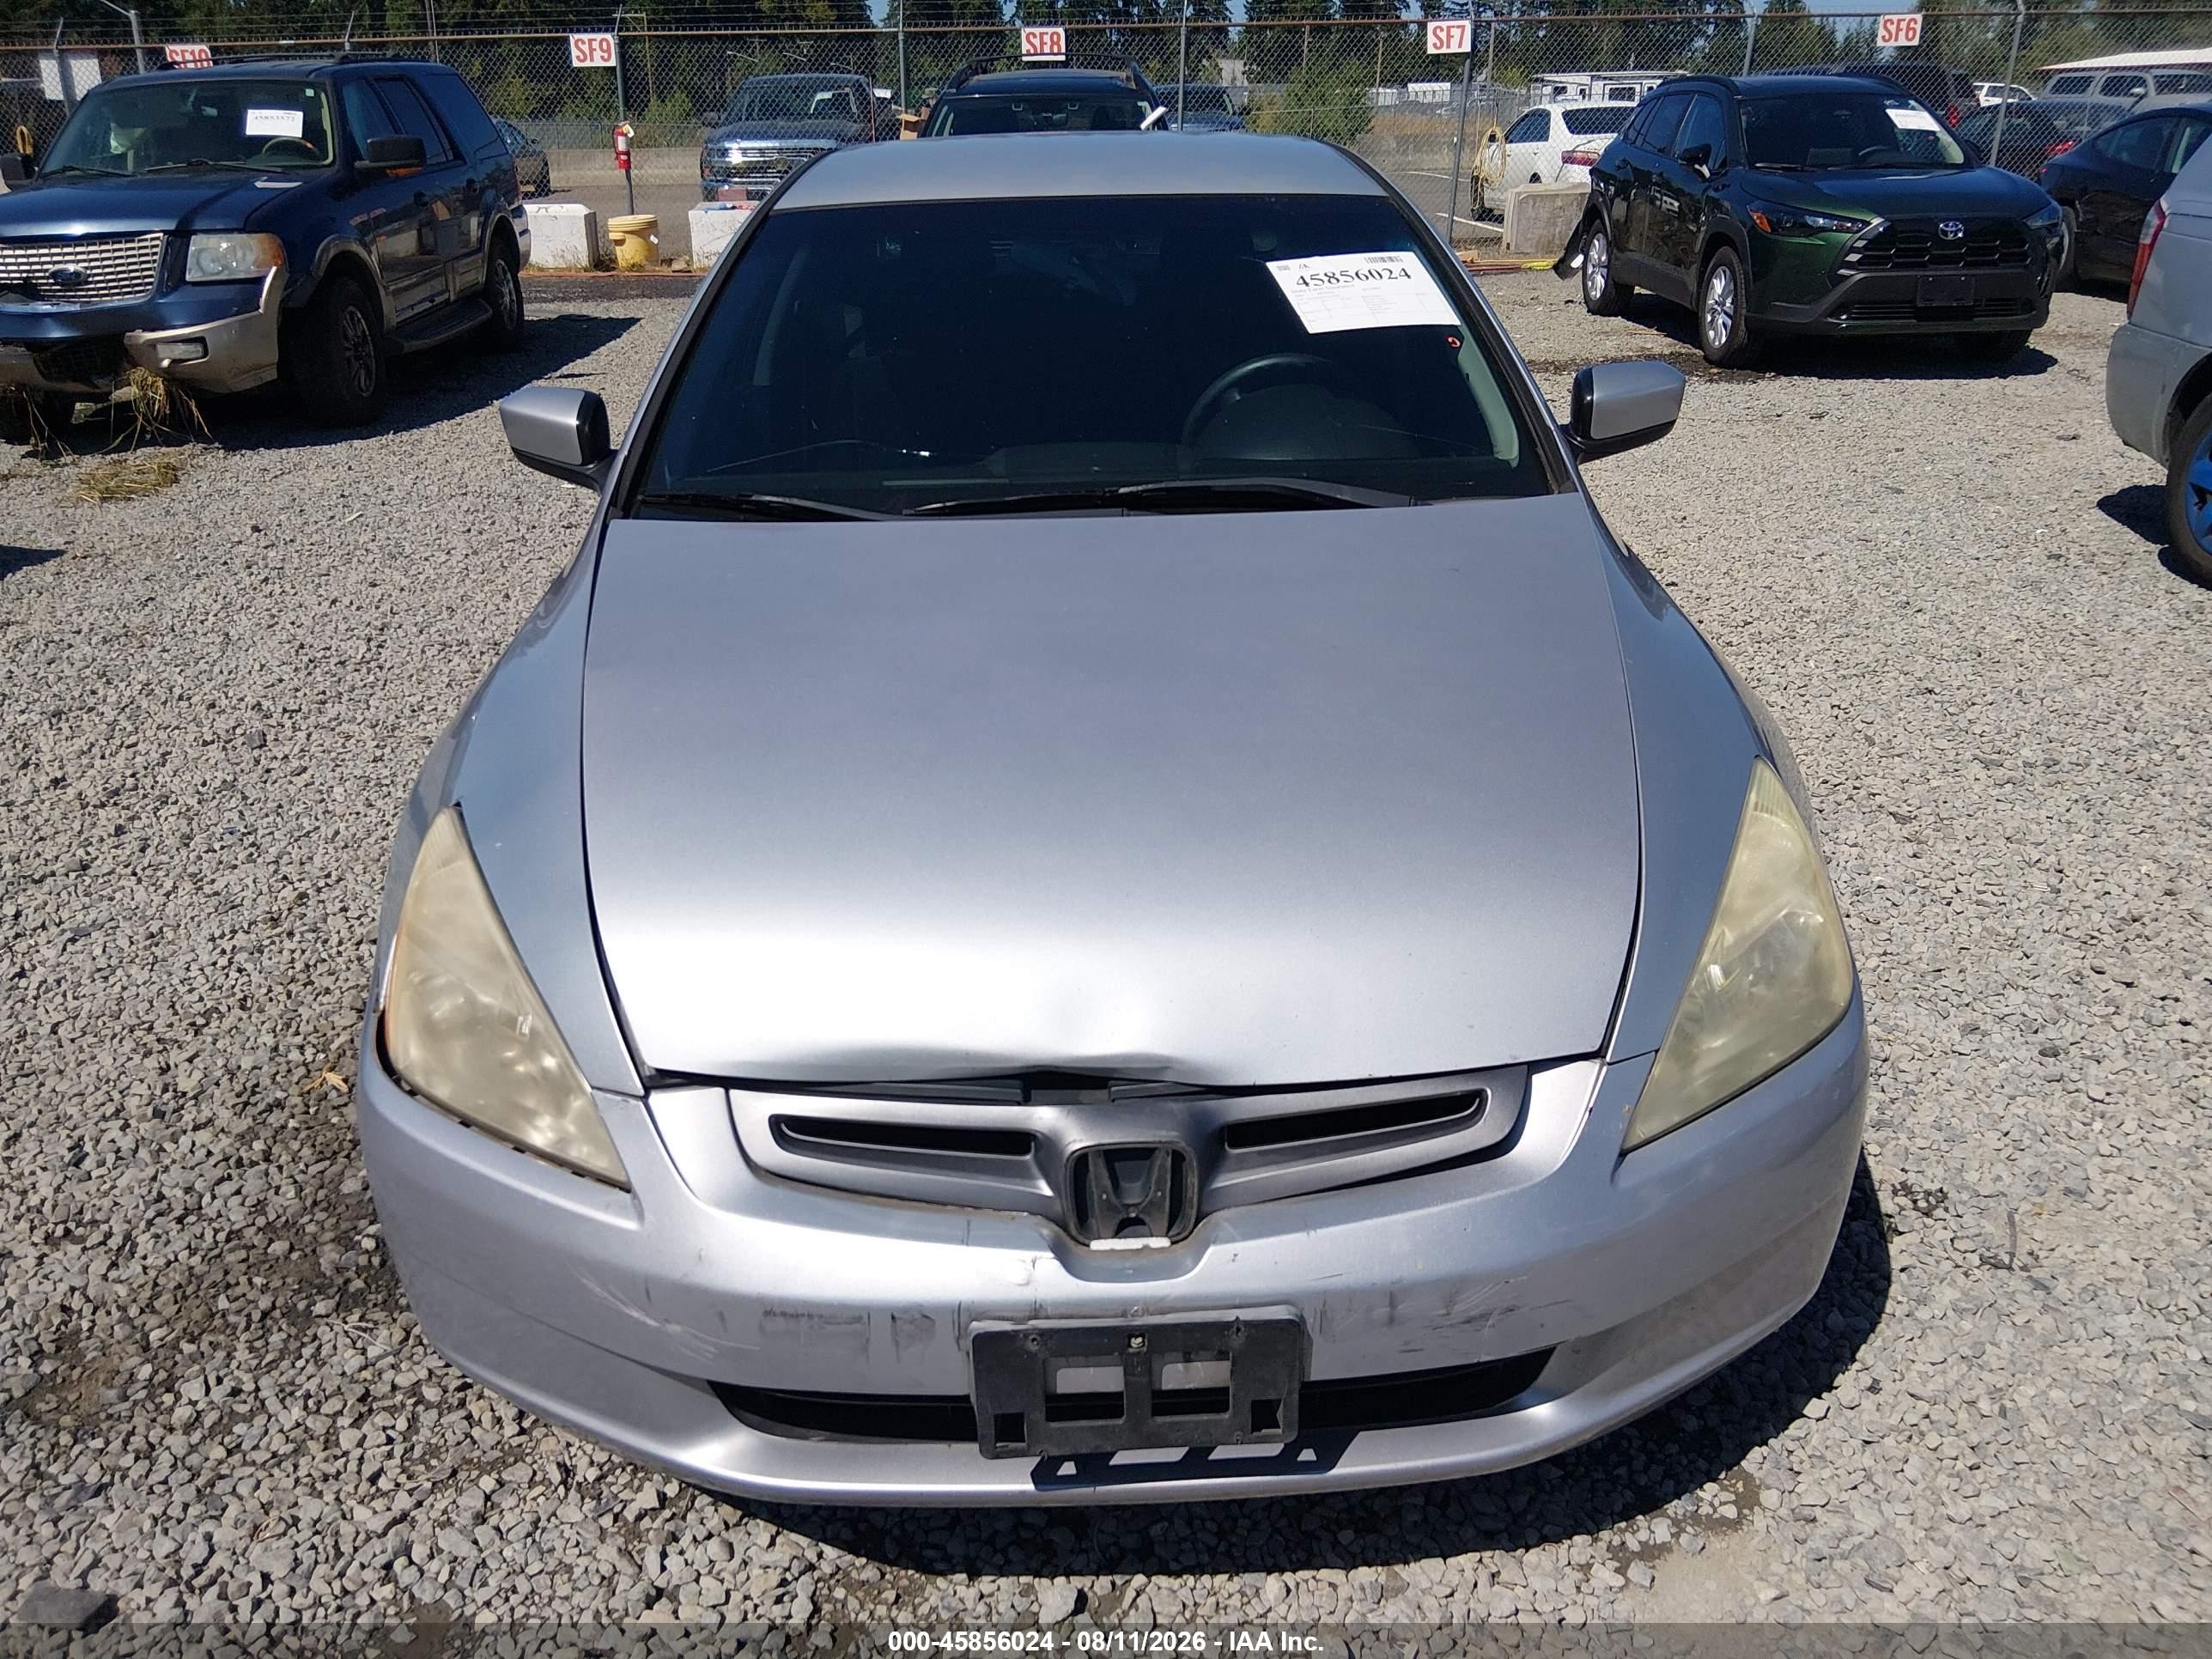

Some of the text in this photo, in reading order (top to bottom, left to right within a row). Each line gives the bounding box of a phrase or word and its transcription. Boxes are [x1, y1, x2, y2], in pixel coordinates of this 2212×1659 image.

[1432, 24, 1466, 50] SF7
[1881, 17, 1917, 43] SF6
[574, 38, 612, 63] SF9
[1025, 32, 1061, 56] SF8
[1297, 267, 1411, 288] 45856024
